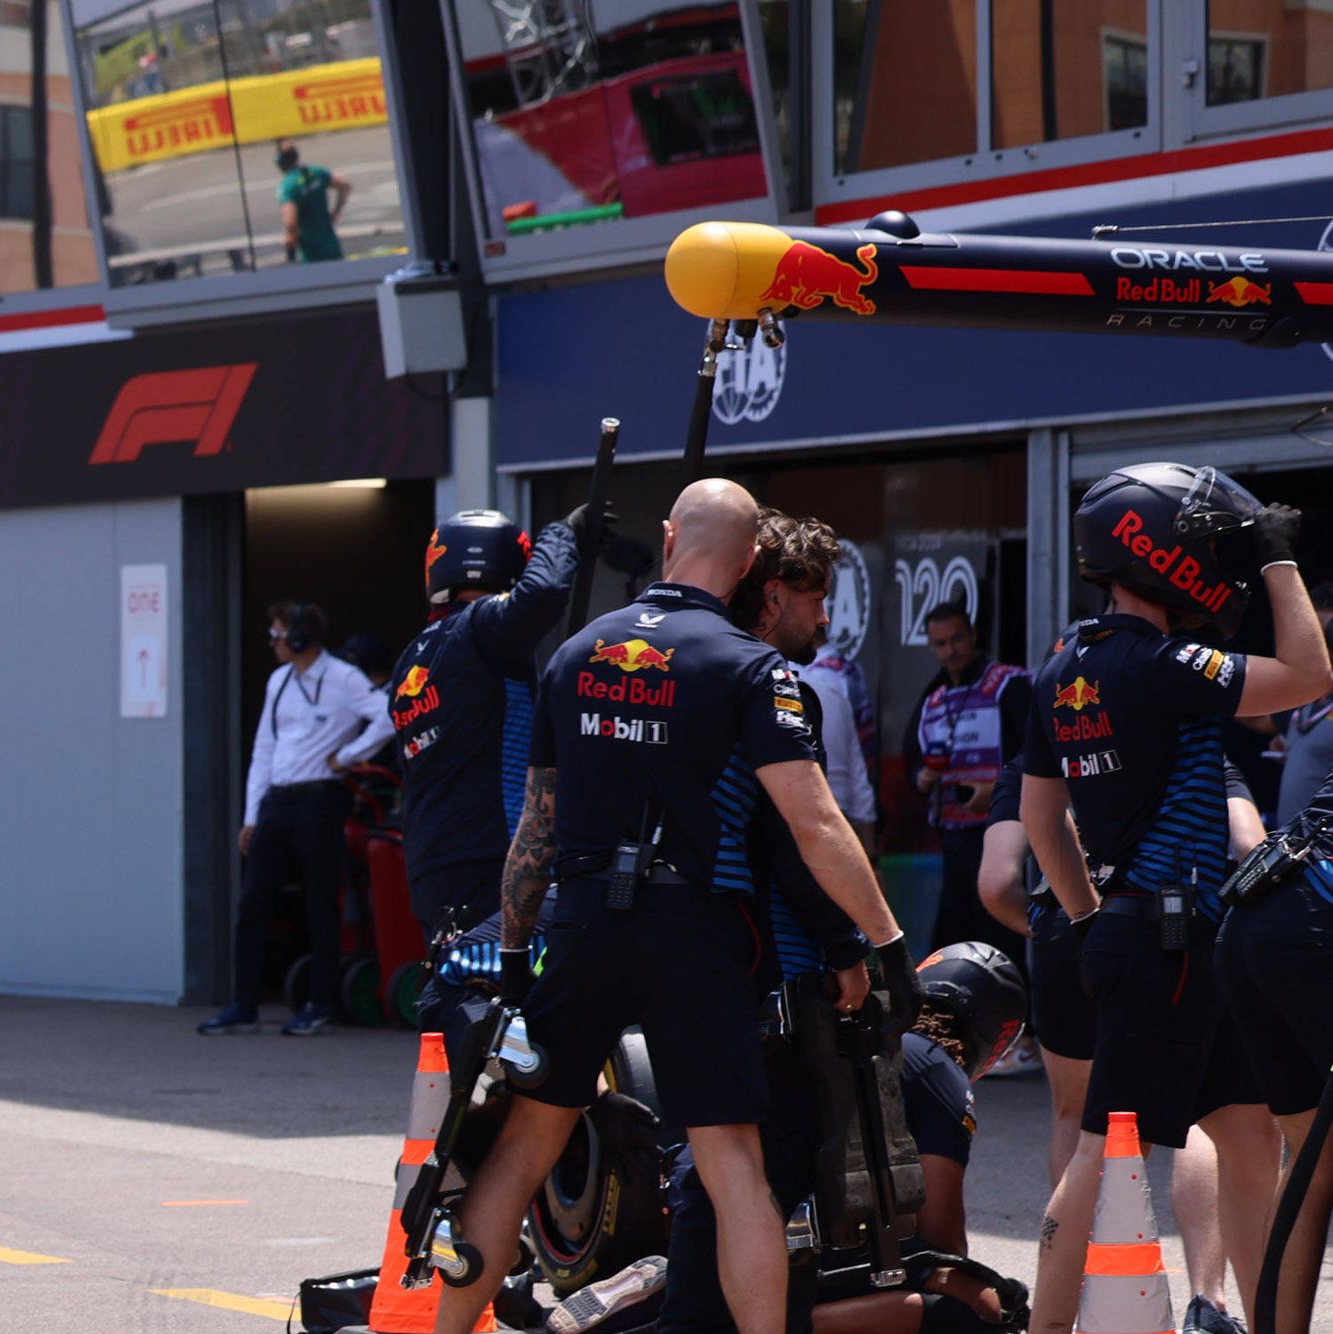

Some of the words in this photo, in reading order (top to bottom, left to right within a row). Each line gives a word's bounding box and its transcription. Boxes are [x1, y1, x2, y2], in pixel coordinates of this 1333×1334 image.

[1110, 248, 1269, 273] ORACLE
[1106, 314, 1267, 331] RACING
[1111, 510, 1182, 574] Red
[1168, 551, 1232, 613] Bull
[577, 671, 626, 702] Red
[629, 678, 676, 708] Bull
[580, 713, 643, 742] Mobil
